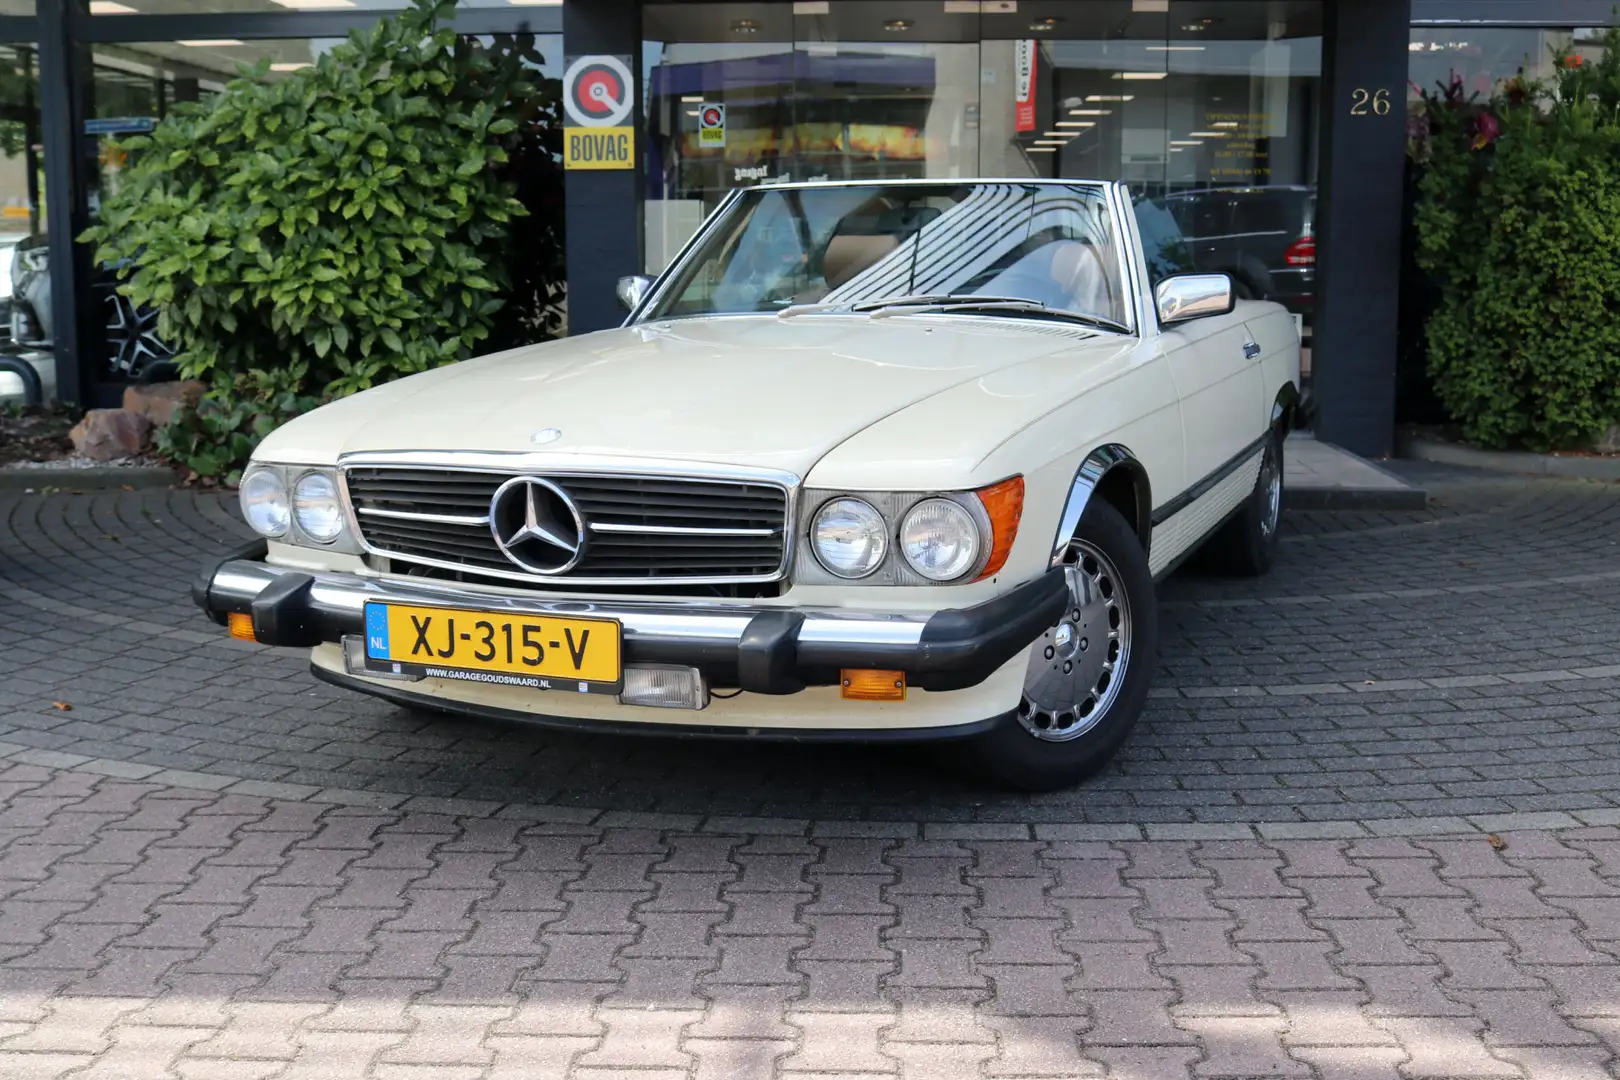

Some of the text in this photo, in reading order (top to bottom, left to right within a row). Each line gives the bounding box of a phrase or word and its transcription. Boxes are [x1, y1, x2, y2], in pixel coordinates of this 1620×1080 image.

[1350, 88, 1391, 116] 26
[570, 133, 629, 162] BOVAG
[370, 636, 387, 650] NL
[410, 614, 590, 670] XJ-315-V
[425, 668, 552, 688] WWW.GARAGEGOUDSWAARD.NL
